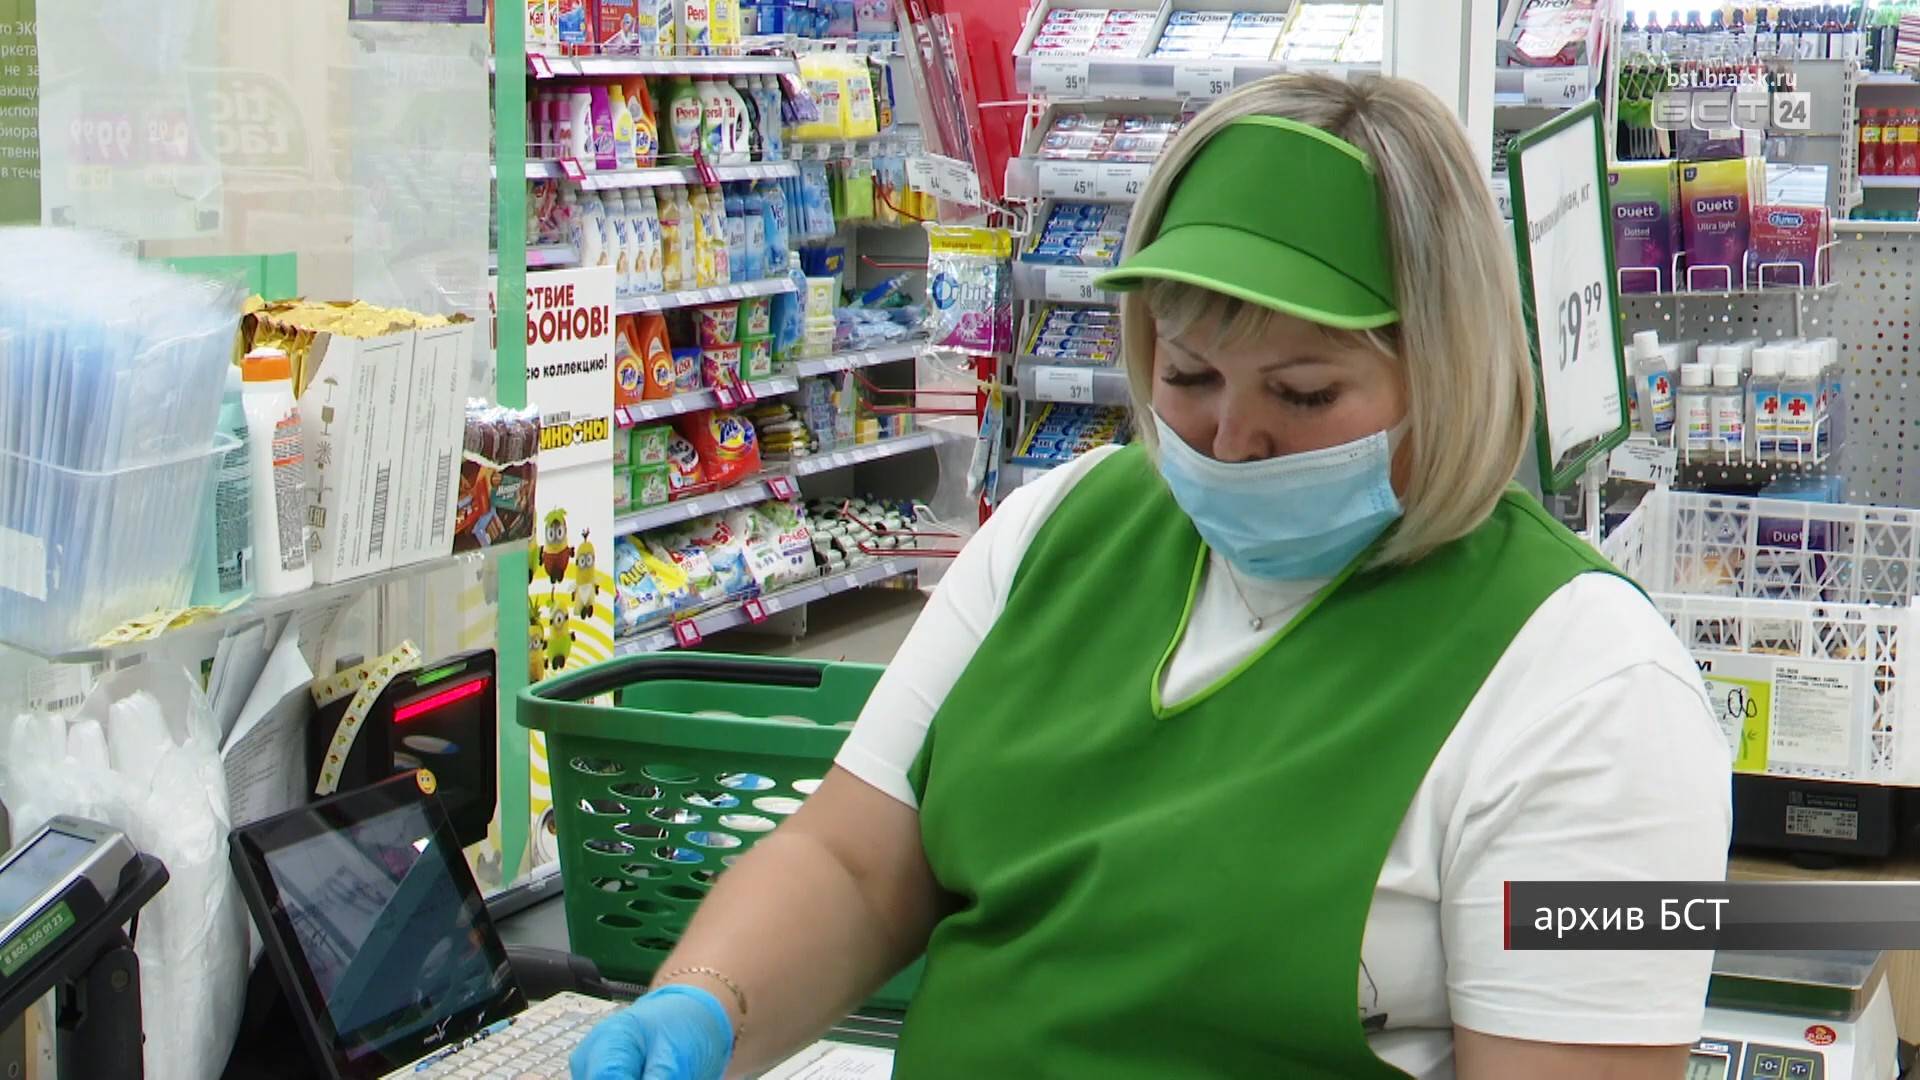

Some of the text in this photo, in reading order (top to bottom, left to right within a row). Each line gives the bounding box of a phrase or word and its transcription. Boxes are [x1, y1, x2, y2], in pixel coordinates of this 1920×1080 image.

[5, 64, 21, 77] не
[1065, 76, 1078, 89] 35
[1210, 81, 1222, 94] 35
[1562, 85, 1577, 99] 49
[1126, 181, 1138, 194] 42
[1616, 205, 1655, 219] Duett
[1696, 200, 1735, 214] Duett
[1559, 291, 1582, 372] 59
[1584, 282, 1602, 316] 99
[543, 353, 608, 378] коллекцию!
[1649, 464, 1663, 479] 71
[1772, 531, 1804, 543] Duet
